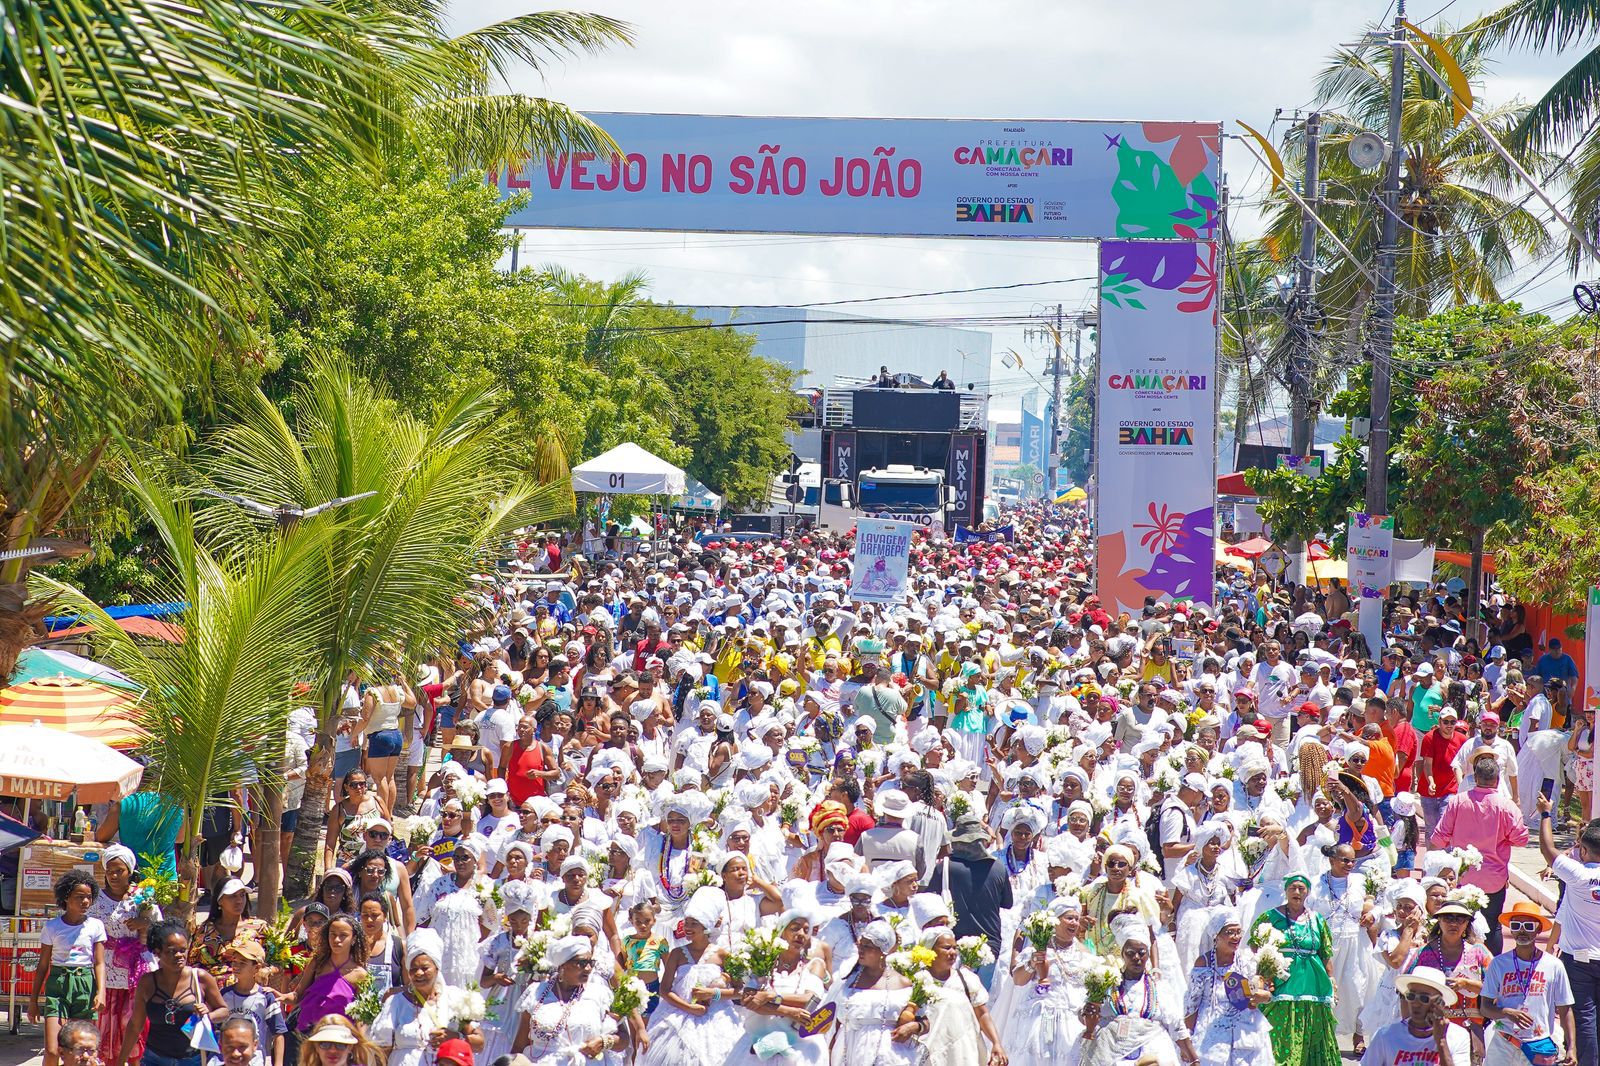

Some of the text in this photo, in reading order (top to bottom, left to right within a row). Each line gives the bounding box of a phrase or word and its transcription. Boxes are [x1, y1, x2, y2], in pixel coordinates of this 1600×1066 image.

[953, 146, 1073, 169] CAMAÇARI
[545, 152, 647, 193] VEJO
[661, 153, 713, 194] NO
[728, 144, 806, 195] SÃO
[819, 146, 922, 197] JOÃO
[956, 203, 1034, 223] BAHIA
[1108, 374, 1206, 393] CAMAÇARI
[1119, 427, 1194, 445] BAHIA
[608, 473, 626, 489] 01
[861, 532, 907, 546] LAVAGEM
[860, 543, 906, 557] AREMBEPE
[10, 777, 63, 797] MALTE
[433, 840, 455, 853] OXE
